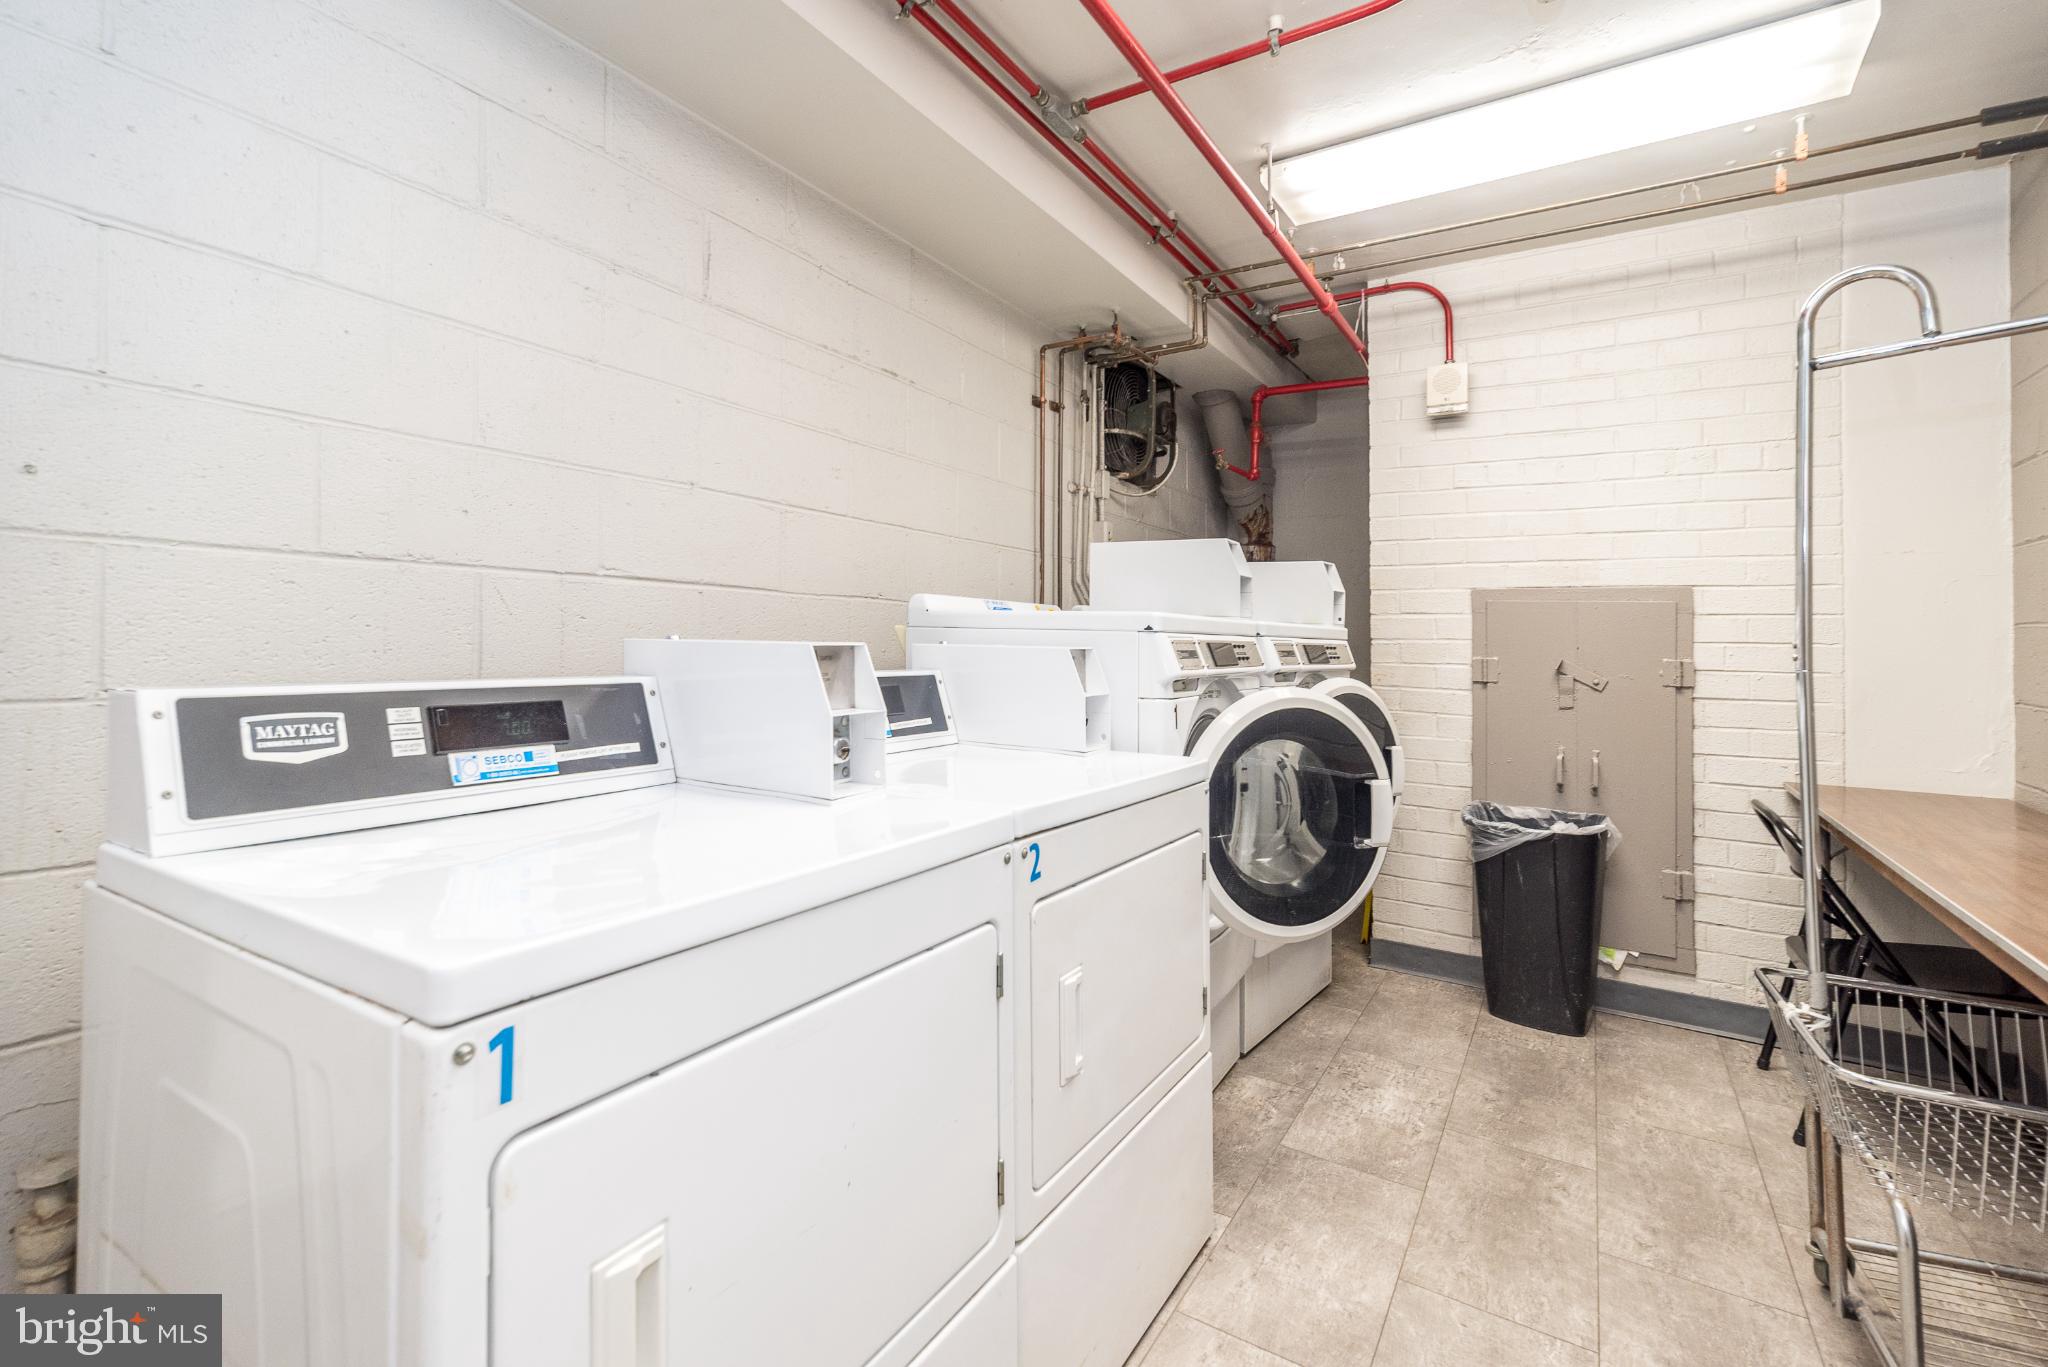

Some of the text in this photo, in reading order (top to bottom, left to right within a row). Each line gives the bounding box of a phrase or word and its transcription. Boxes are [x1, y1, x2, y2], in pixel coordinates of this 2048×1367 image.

[255, 722, 335, 739] MAYTAG
[484, 753, 522, 765] SEBCO
[1029, 842, 1041, 882] 2
[489, 1025, 514, 1105] 1
